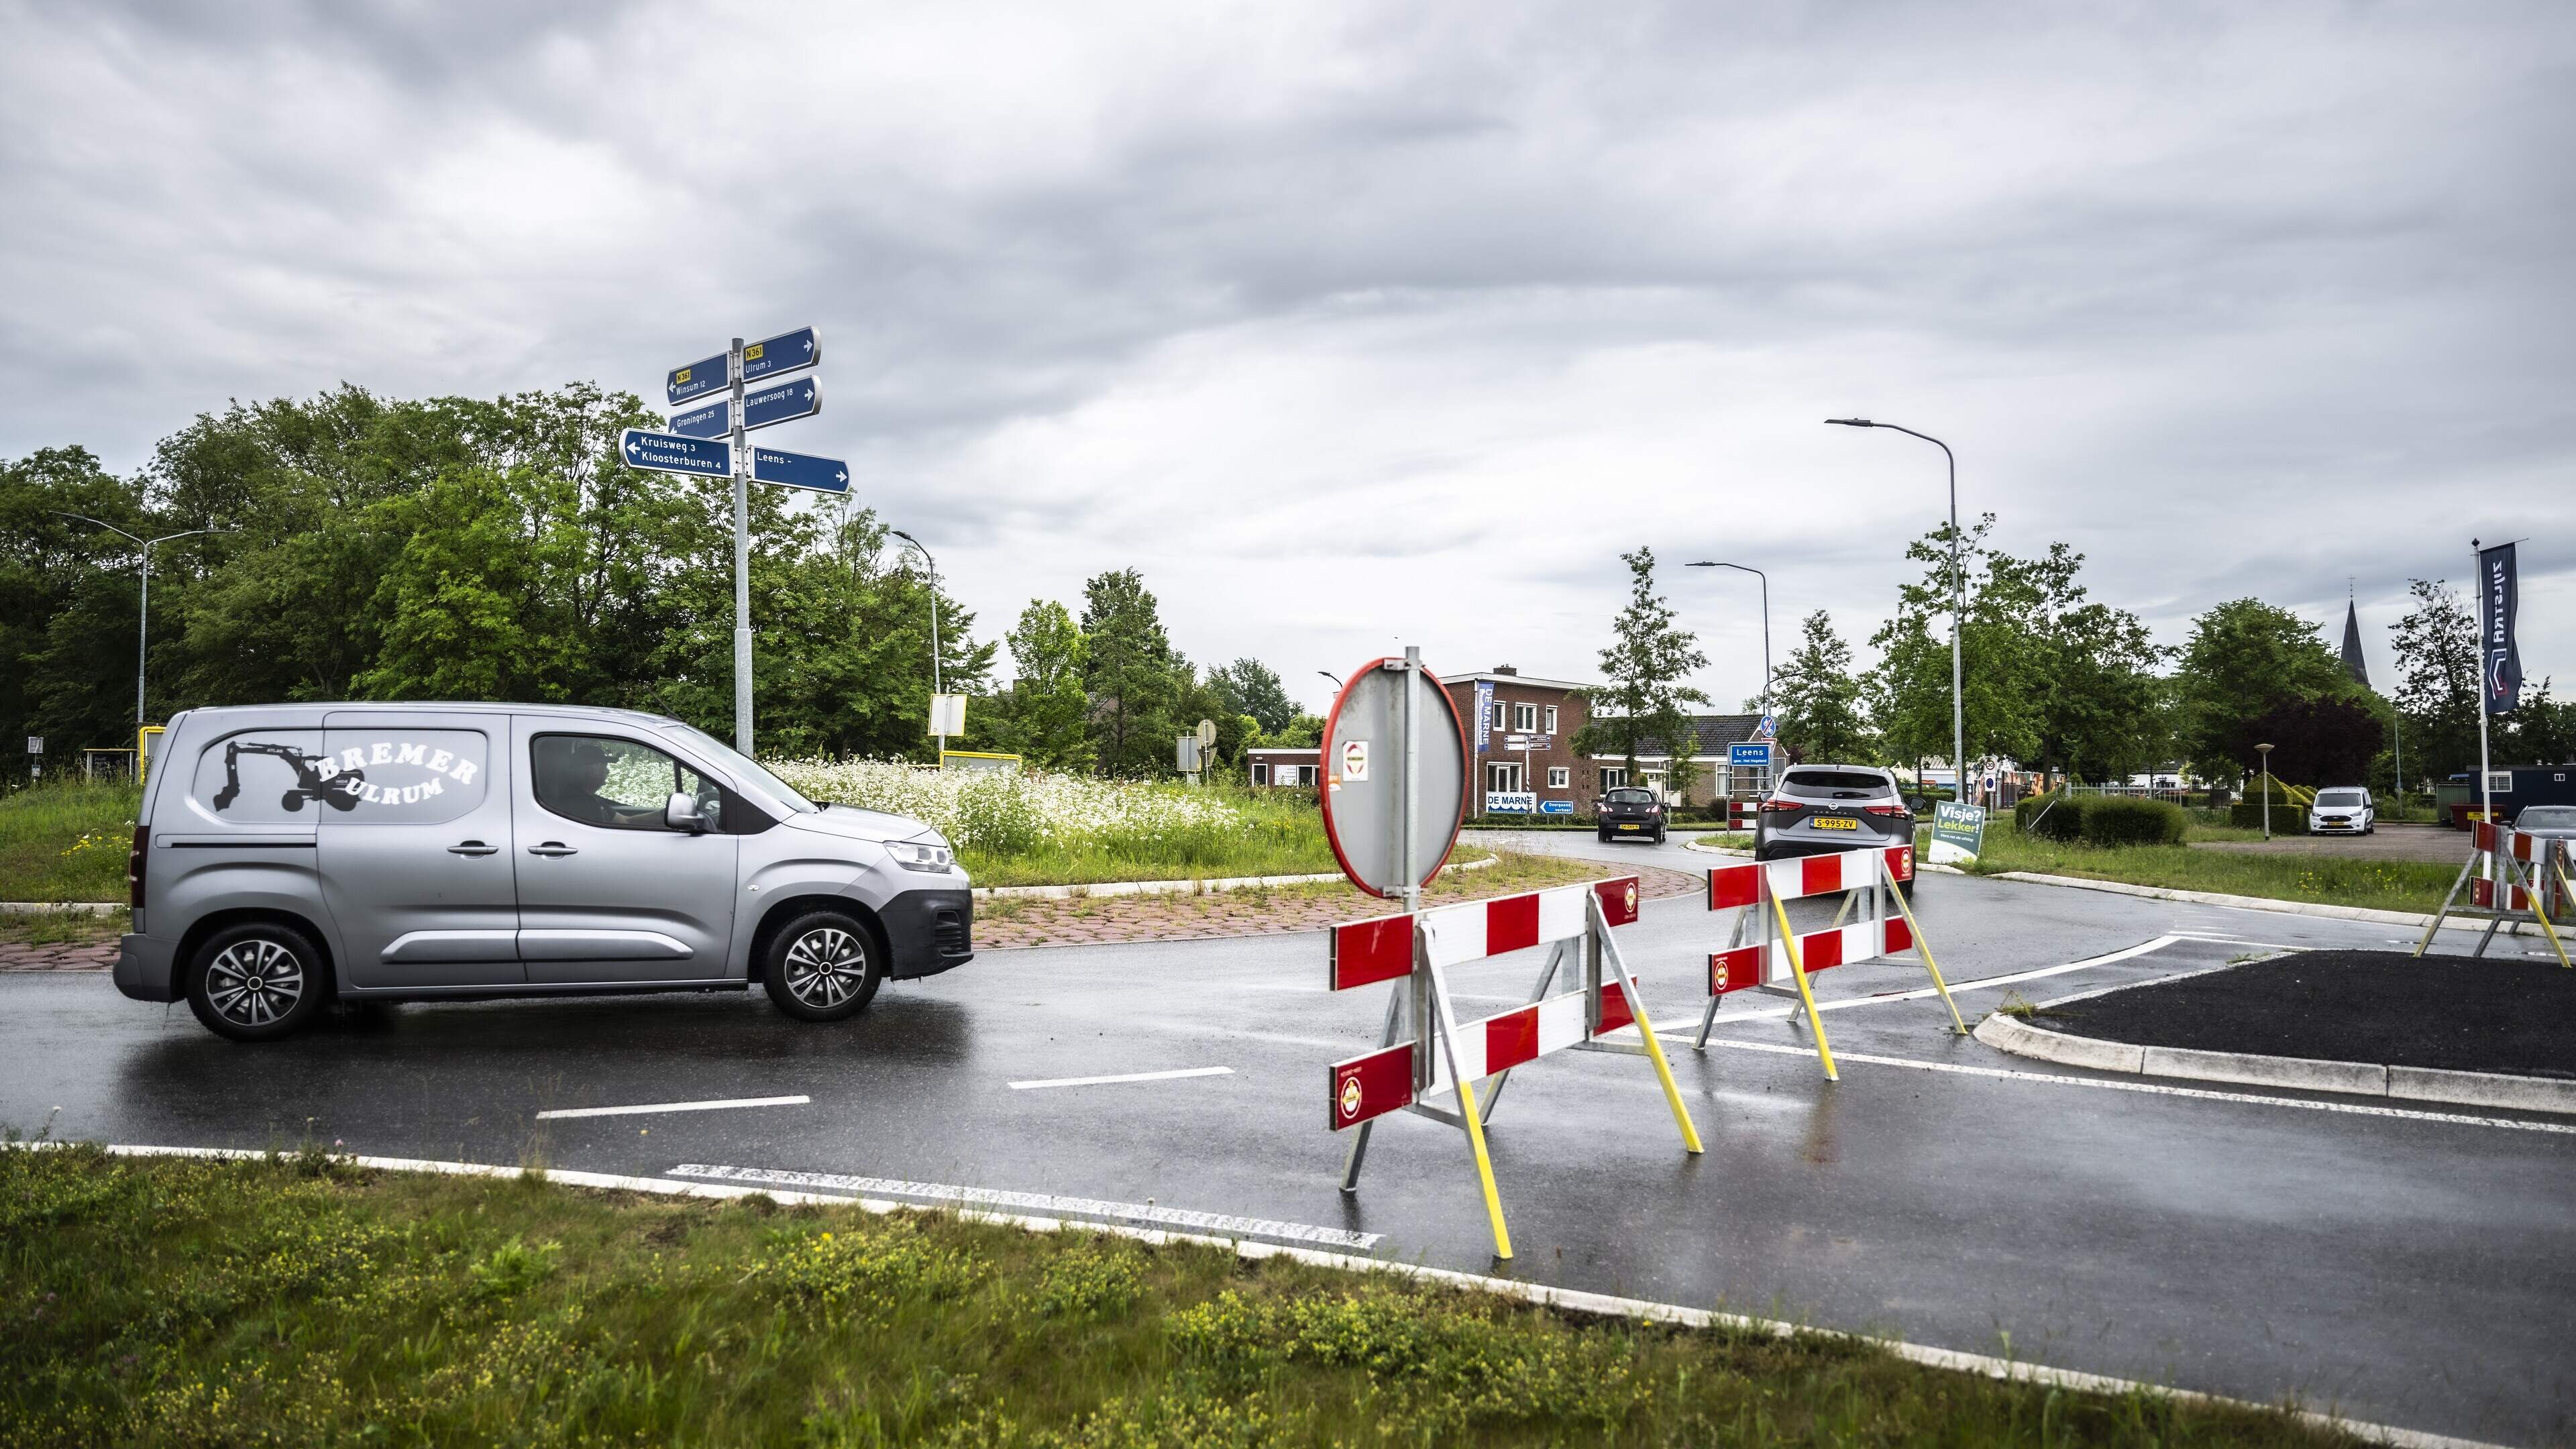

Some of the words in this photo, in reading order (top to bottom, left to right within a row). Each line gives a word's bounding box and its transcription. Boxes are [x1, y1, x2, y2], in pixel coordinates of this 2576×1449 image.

[745, 362, 765, 373] Ulrum
[676, 382, 698, 395] Winsum
[746, 390, 785, 407] Lauwersoog
[787, 388, 793, 396] 18
[677, 413, 706, 427] Groningen
[708, 410, 714, 418] 25
[641, 436, 687, 453] Kruisweg
[642, 451, 712, 468] Kloosterburen
[757, 451, 784, 464] Leens
[1485, 688, 1493, 703] DE
[1483, 706, 1492, 745] MARNE
[315, 743, 478, 785] BREMER
[345, 777, 444, 805] ULRUM
[1488, 796, 1499, 804] DE
[1501, 796, 1532, 804] MARNE
[1940, 805, 1982, 822] Visje?
[1817, 819, 1854, 828] S-995-ZV
[1937, 818, 1980, 833] Lekker!
